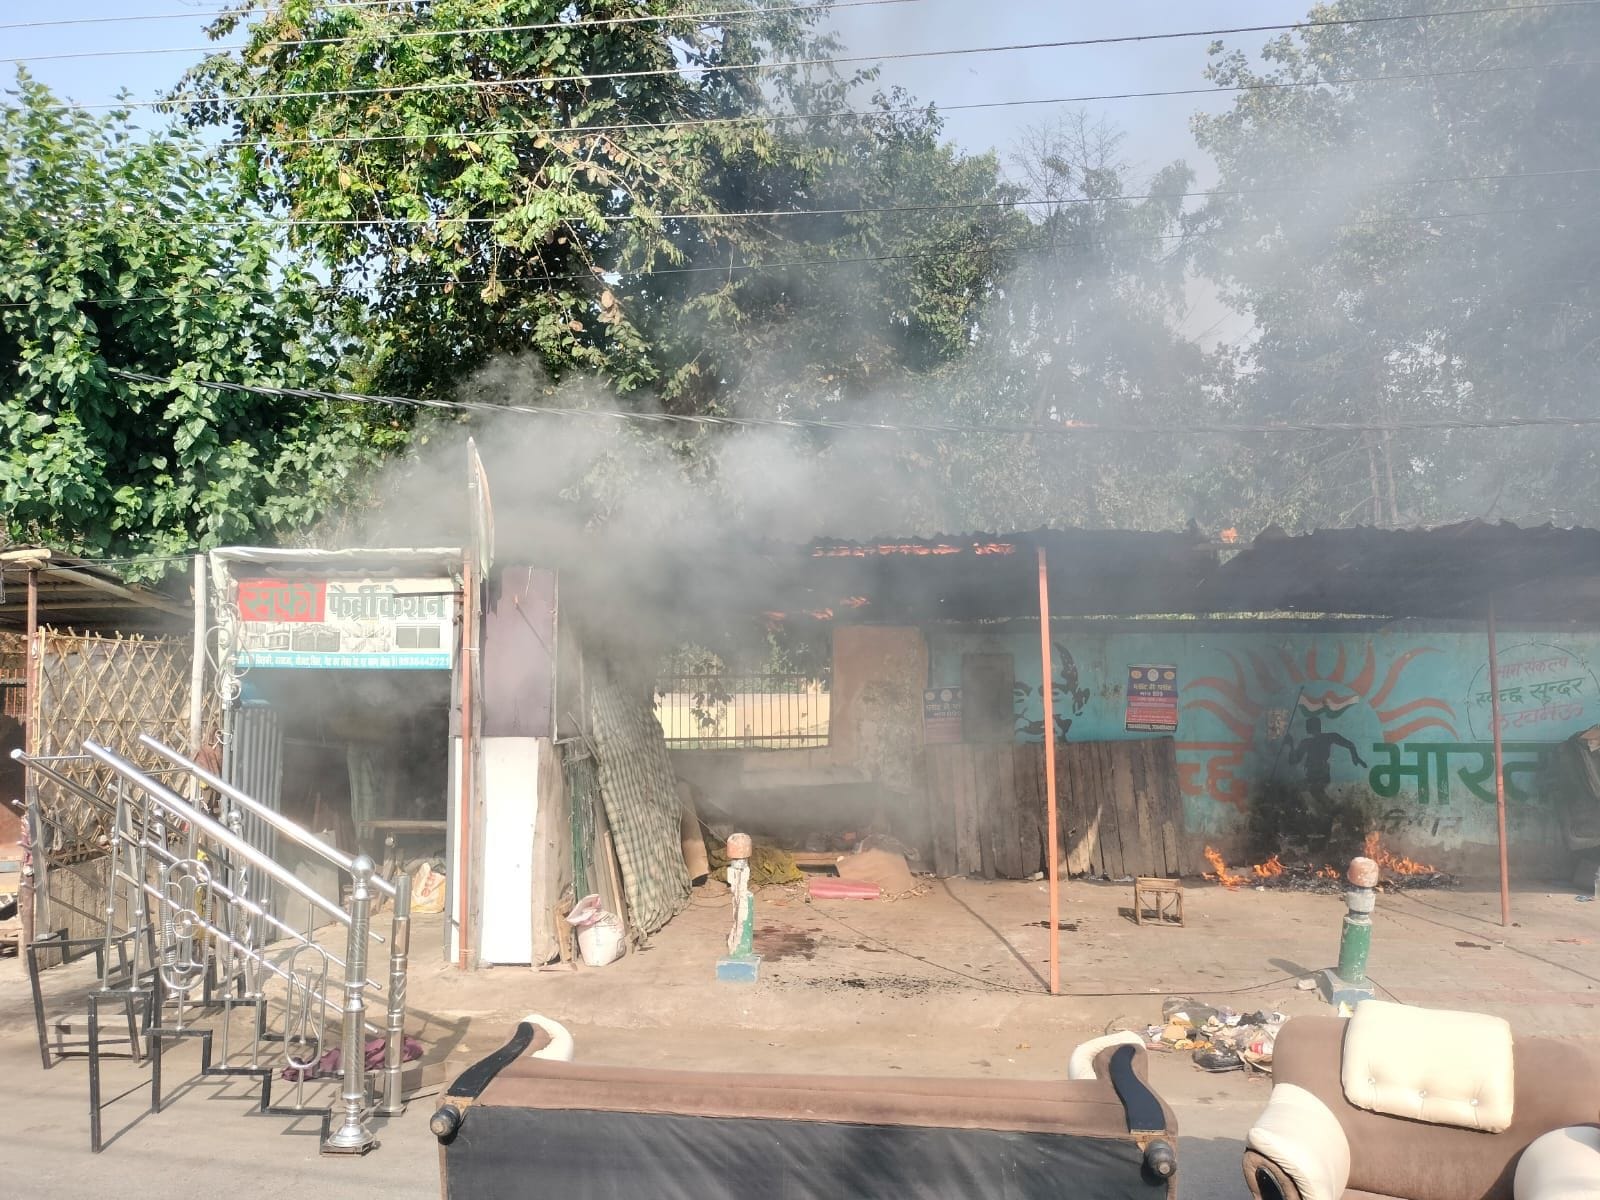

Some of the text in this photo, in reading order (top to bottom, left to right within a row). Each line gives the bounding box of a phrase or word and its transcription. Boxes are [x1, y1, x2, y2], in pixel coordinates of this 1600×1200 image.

[1488, 660, 1519, 680] मारा
[1528, 677, 1586, 706] सुन्दर
[1369, 742, 1550, 804] भारत
